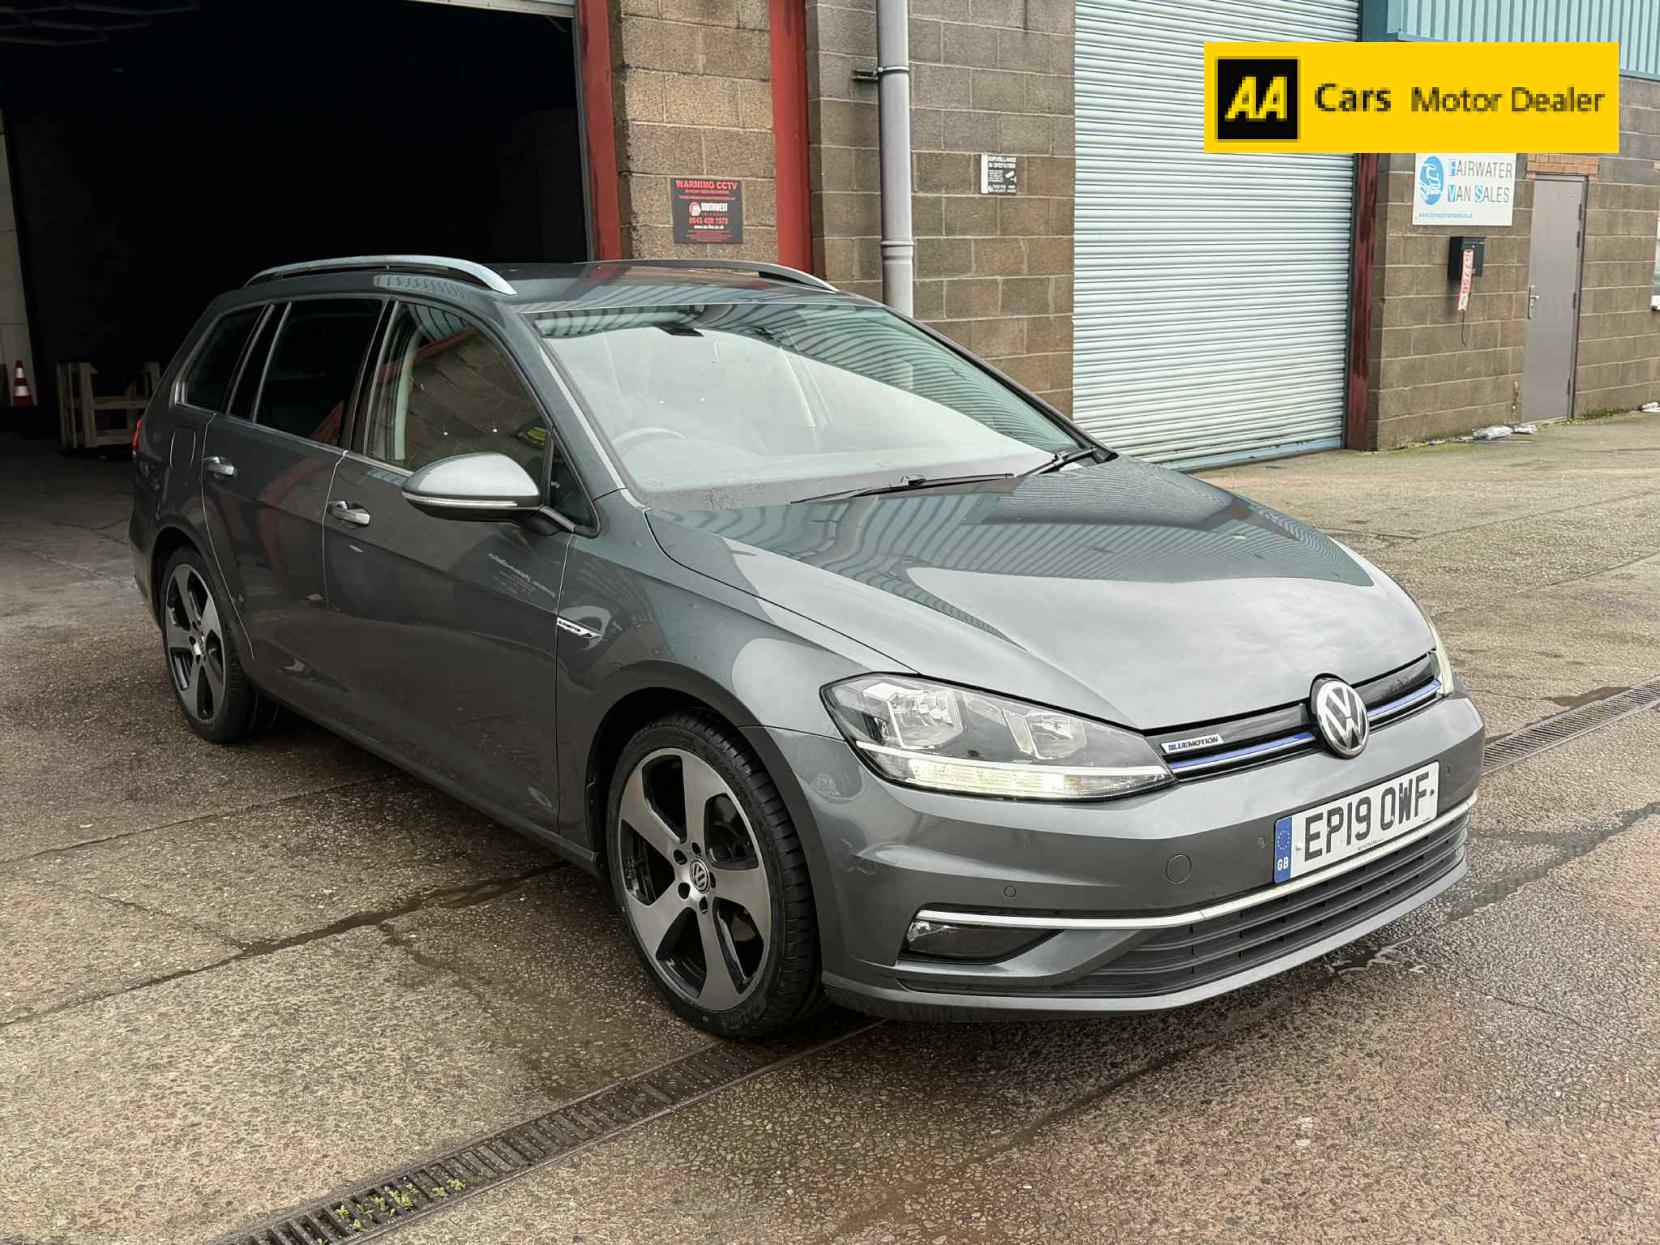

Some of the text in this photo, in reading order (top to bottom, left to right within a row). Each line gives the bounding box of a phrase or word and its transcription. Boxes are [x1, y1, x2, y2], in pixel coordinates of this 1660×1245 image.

[1448, 158, 1513, 179] FAIRWATER
[675, 180, 738, 190] WARNING CCTV
[1447, 184, 1510, 203] VAN SALES
[1304, 771, 1429, 862] EP19 OWF
[1277, 856, 1289, 871] GB
